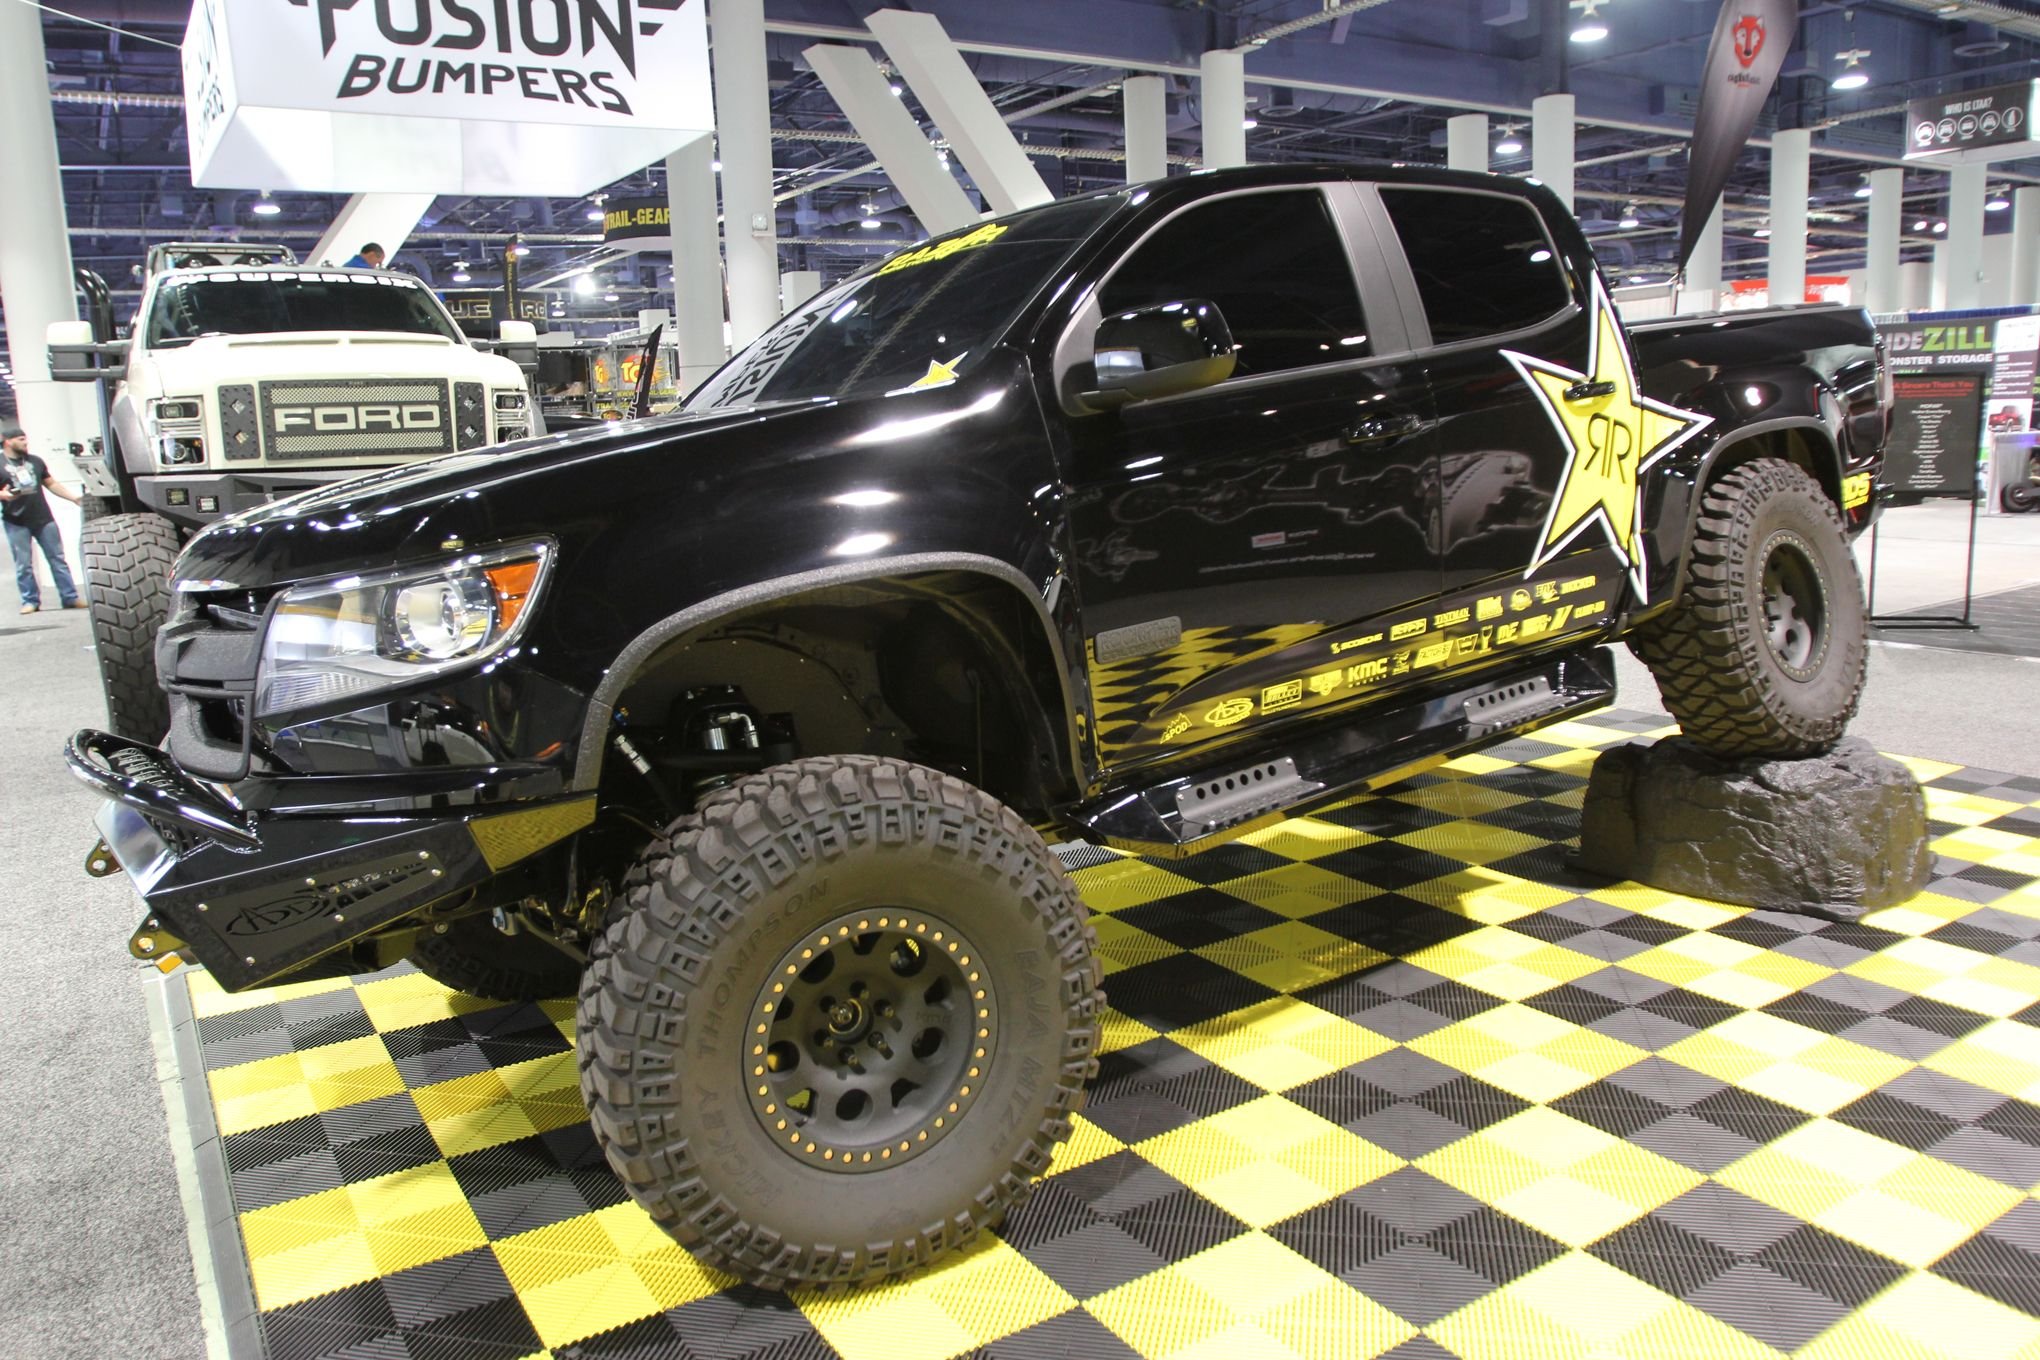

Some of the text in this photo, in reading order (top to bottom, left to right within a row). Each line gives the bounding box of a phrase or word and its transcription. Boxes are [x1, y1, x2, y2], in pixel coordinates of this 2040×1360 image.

[336, 53, 633, 116] BUMPERS
[1938, 353, 1993, 364] STORAGE
[274, 404, 440, 432] FORD
[1348, 657, 1389, 682] KMC
[697, 876, 829, 1058] THOMPSON
[1015, 950, 1050, 1040] BAJA
[1000, 1056, 1044, 1132] MTZ
